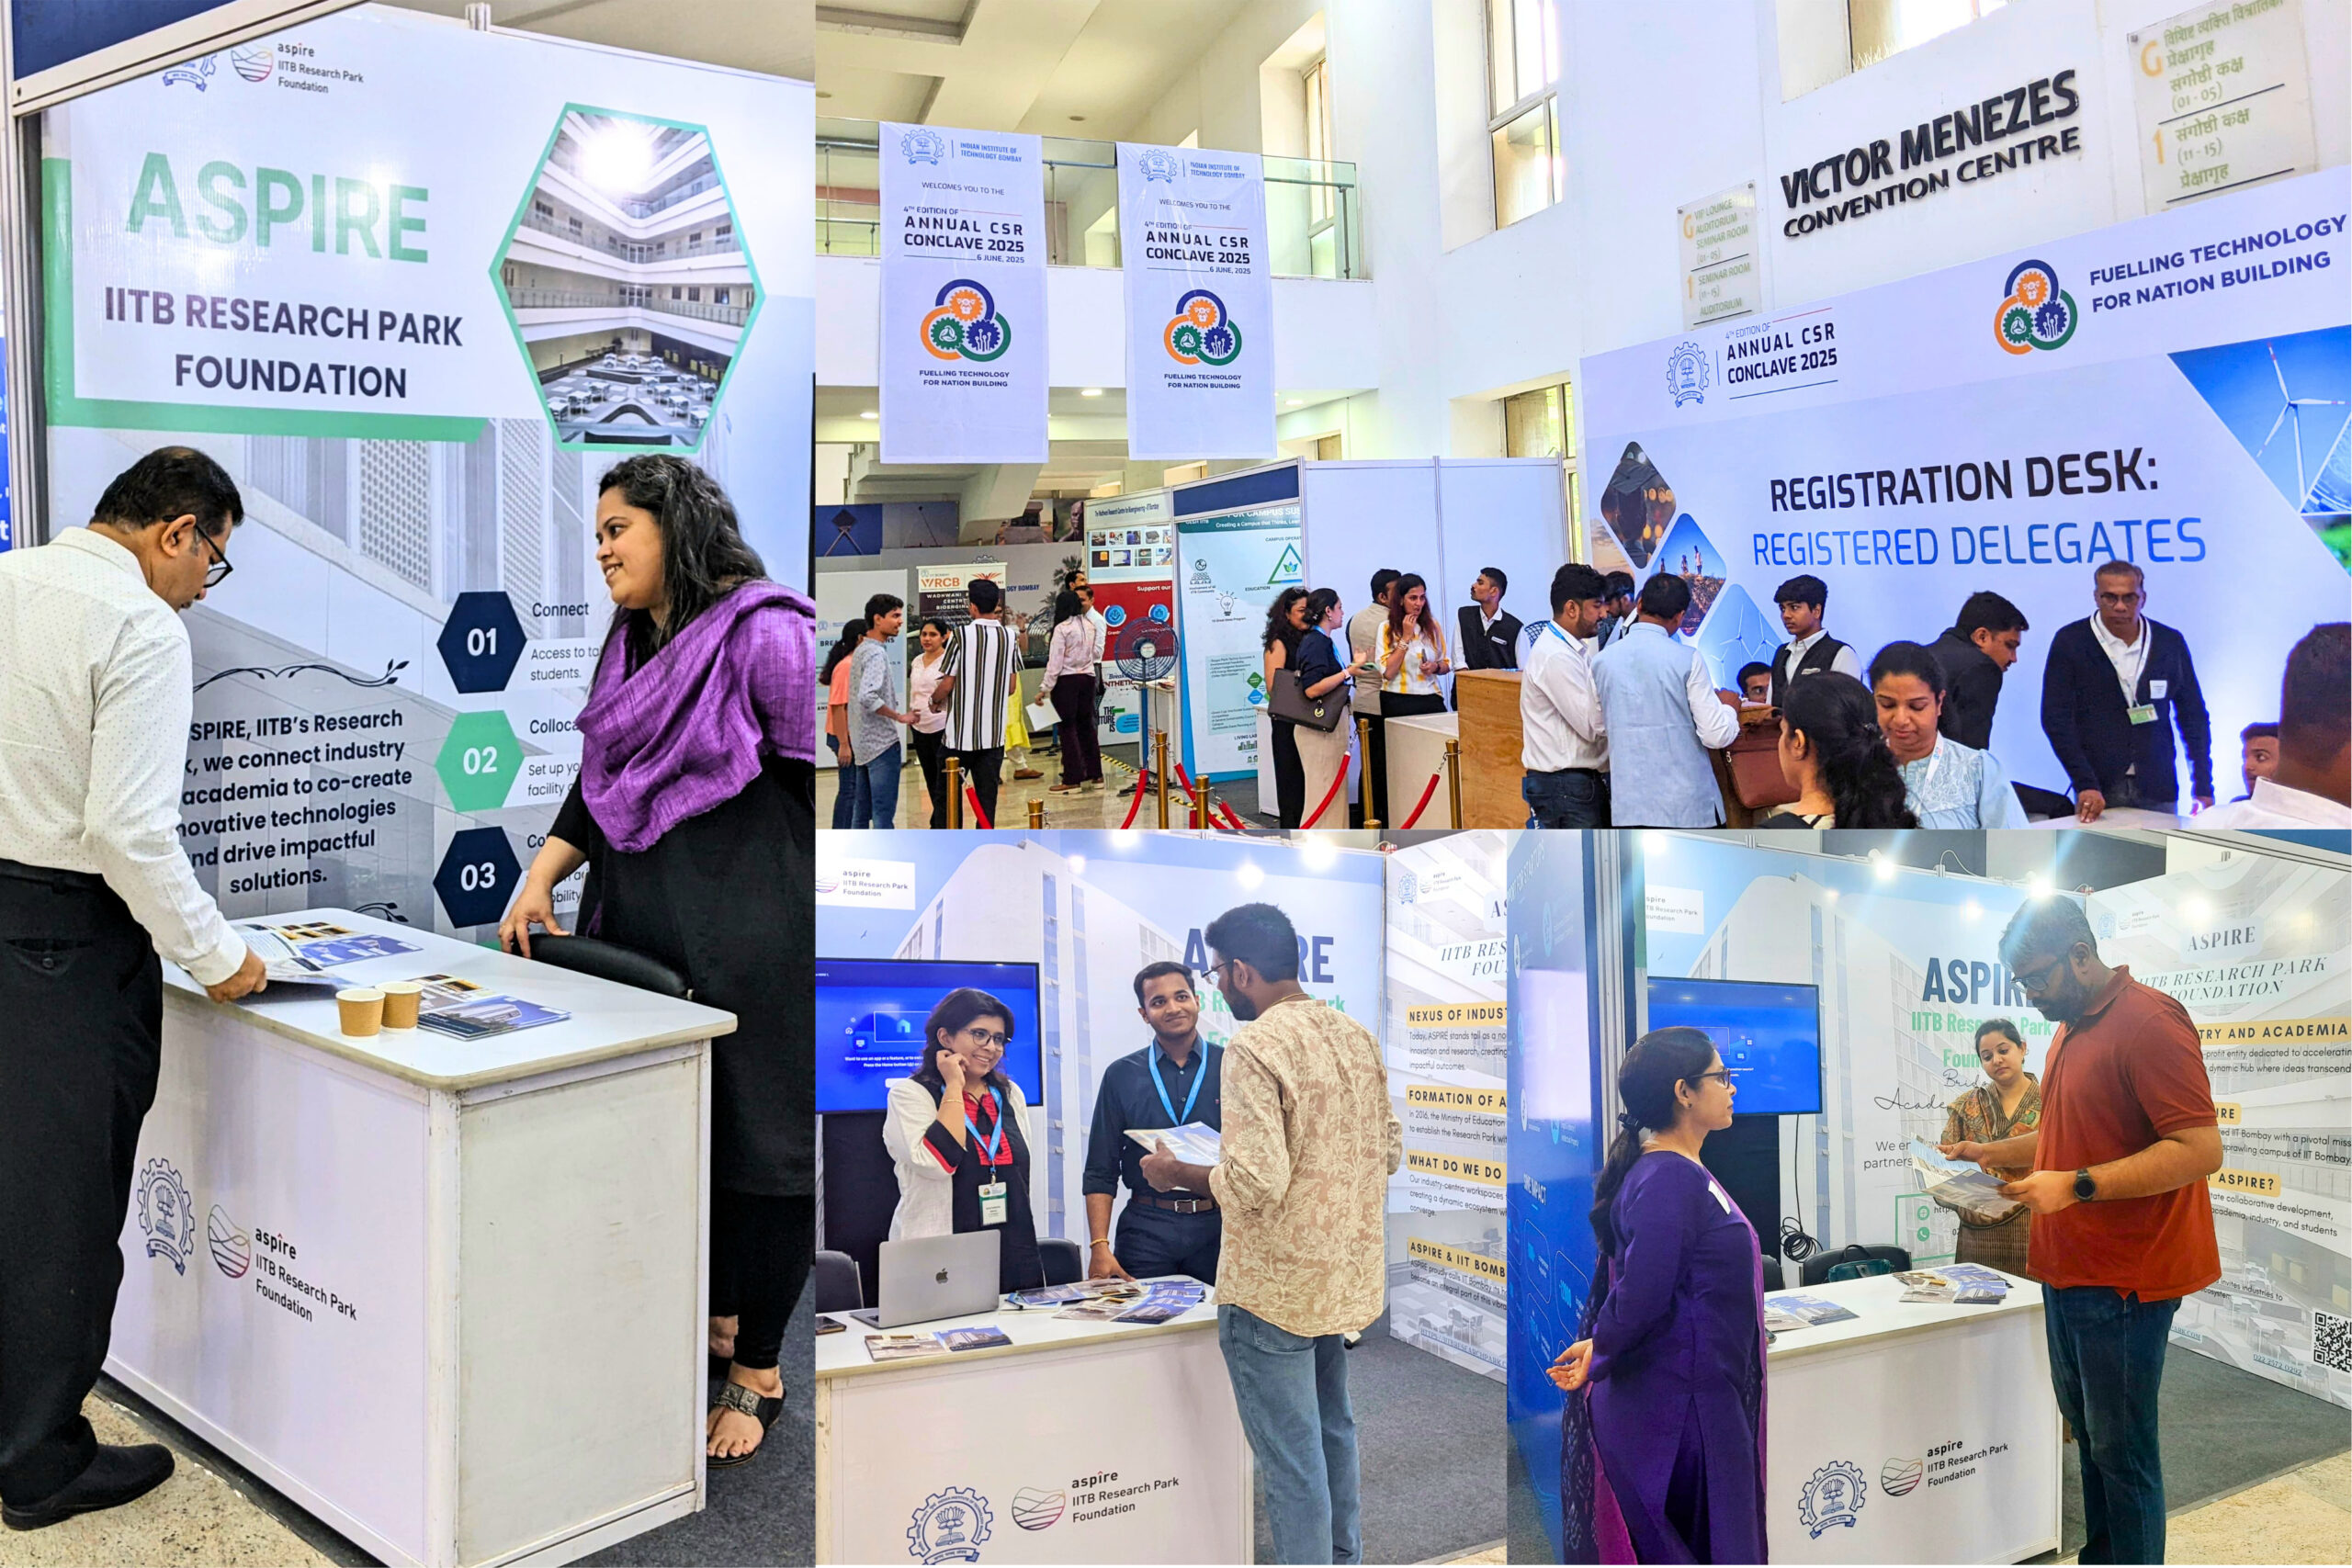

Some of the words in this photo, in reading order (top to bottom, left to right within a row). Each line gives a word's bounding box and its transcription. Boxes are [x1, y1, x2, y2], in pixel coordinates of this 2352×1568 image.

[2141, 39, 2164, 77] G
[278, 60, 297, 72] IITB
[300, 63, 341, 79] Research
[343, 71, 365, 84] Park
[278, 77, 328, 93] Foundation
[960, 142, 980, 151] INDIAN
[981, 144, 1009, 153] INSTITUTE
[1780, 139, 1894, 209] VICTOR
[1900, 69, 2080, 171] MENEZES
[961, 150, 997, 160] TECHNOLOGY
[998, 154, 1023, 163] BOMBAY
[922, 182, 962, 191] WELCOMES
[1783, 168, 1950, 238] CONVENTION
[1956, 126, 2081, 184] CENTRE
[125, 152, 428, 264] ASPIRE
[1706, 198, 1733, 217] LOUNGE
[904, 216, 981, 232] ANNUAL
[989, 221, 1023, 235] CSR
[1683, 214, 1695, 240] G
[1695, 212, 1738, 234] AUDITORIUM
[904, 233, 983, 250] CONCLAVE
[988, 239, 1024, 253] 2025
[1146, 231, 1213, 246] ANNUAL
[1219, 236, 1249, 248] CSR
[1696, 231, 1726, 250] SEMINAR
[1726, 224, 1749, 240] ROOM
[1146, 247, 1215, 262] CONCLAVE
[1218, 252, 1250, 265] 2025
[2089, 252, 2185, 286] FUELLING
[2189, 214, 2347, 264] TECHNOLOGY
[1698, 268, 1728, 286] SEMINAR
[1728, 262, 1751, 277] ROOM
[2092, 291, 2132, 312] FOR
[2136, 275, 2215, 305] NATION
[2221, 251, 2331, 288] BUILDING
[105, 287, 175, 324] IITB
[186, 294, 368, 340] RESEARCH
[379, 310, 463, 346] PARK
[1700, 297, 1743, 317] AUDITORIUM
[1727, 332, 1794, 361] ANNUAL
[1802, 322, 1836, 345] CSR
[920, 369, 956, 378] FUELLING
[958, 370, 1010, 378] TECHNOLOGY
[1727, 355, 1797, 384] CONCLAVE
[1801, 347, 1838, 371] 2025
[175, 354, 406, 399] FOUNDATION
[972, 379, 1008, 388] BUILDING
[1198, 373, 1242, 381] TECHNOLOGY
[1770, 459, 2013, 513] REGISTRATION
[2026, 447, 2159, 497] DESK:
[1753, 527, 1939, 566] REGISTERED
[1951, 517, 2207, 566] DELEGATES
[921, 577, 960, 588] WRCB
[532, 603, 590, 617] Connect
[467, 627, 497, 656] 01
[531, 648, 571, 660] Access
[530, 668, 582, 681] students.
[190, 720, 251, 740] SPIRE,
[256, 716, 309, 737] IITB's
[314, 709, 403, 733] Research
[529, 719, 579, 734] Colloca
[204, 755, 233, 773] we
[238, 746, 322, 770] connect
[325, 741, 405, 761] industry
[463, 746, 498, 774] 02
[528, 764, 547, 776] Set
[549, 765, 564, 778] up
[182, 778, 288, 805] academia
[293, 778, 313, 795] to
[317, 769, 413, 791] co-create
[528, 784, 564, 797] facility
[175, 812, 266, 837] novative
[271, 798, 396, 825] technologies
[223, 842, 277, 863] drive
[280, 829, 375, 860] impactful
[230, 868, 327, 894] solutions.
[460, 862, 496, 891] 03
[842, 870, 871, 878] aspire
[843, 889, 882, 897] Foundation
[1656, 906, 1683, 914] Research
[2188, 926, 2256, 952] ASPIRE
[1441, 945, 1472, 962] IITB
[2174, 964, 2265, 987] RESEARCH
[2271, 956, 2328, 976] PARK
[1922, 957, 2038, 1008] ASPIR
[1409, 1010, 1442, 1021] NEXUS
[1448, 1010, 1462, 1021] OF
[1467, 1008, 1507, 1020] INDUS
[1912, 1011, 1943, 1032] IITB
[2021, 1017, 2052, 1036] Park
[2228, 1028, 2256, 1039] AND
[2262, 1023, 2348, 1038] ACADEMIA
[2248, 1047, 2290, 1057] dedicated
[2256, 1064, 2280, 1073] where
[2307, 1063, 2351, 1074] transcend
[1408, 1090, 1472, 1105] FORMATION
[1478, 1095, 1493, 1106] OF
[1874, 1088, 1948, 1110] Acade
[1472, 1115, 1505, 1127] Education
[1453, 1129, 1480, 1140] Research
[2241, 1129, 2272, 1142] Bombay
[2301, 1135, 2330, 1145] pivotal
[1876, 1141, 1895, 1152] We
[2259, 1146, 2290, 1158] campus
[1409, 1155, 1439, 1168] WHAT
[1443, 1159, 1458, 1172] DO
[1463, 1163, 1479, 1176] WE
[1485, 1167, 1501, 1179] DO
[1864, 1157, 1913, 1171] partners
[2218, 1173, 2275, 1190] ASPIRE?
[2226, 1194, 2275, 1210] collaborative
[2277, 1201, 2334, 1221] development,
[2301, 1223, 2338, 1237] students
[255, 1228, 297, 1259] aspire
[1410, 1242, 1442, 1259] ASPIRE
[1456, 1254, 1470, 1267] IIT
[1475, 1259, 1506, 1278] BOMB
[256, 1253, 276, 1276] IITB
[278, 1265, 327, 1304] Research
[331, 1293, 357, 1321] Park
[256, 1278, 312, 1323] Foundation
[2253, 1353, 2267, 1363] 022
[2267, 1358, 2284, 1369] 2572
[1927, 1440, 1963, 1457] aspire
[1928, 1460, 1946, 1473] IITB
[1948, 1449, 1987, 1467] Research
[1989, 1443, 2008, 1455] Park
[1071, 1470, 1118, 1489] aspire
[1928, 1467, 1976, 1488] Foundation
[1072, 1493, 1095, 1506] IITB
[1099, 1483, 1150, 1502] Research
[1154, 1477, 1180, 1491] Park
[1072, 1503, 1136, 1523] Foundation
